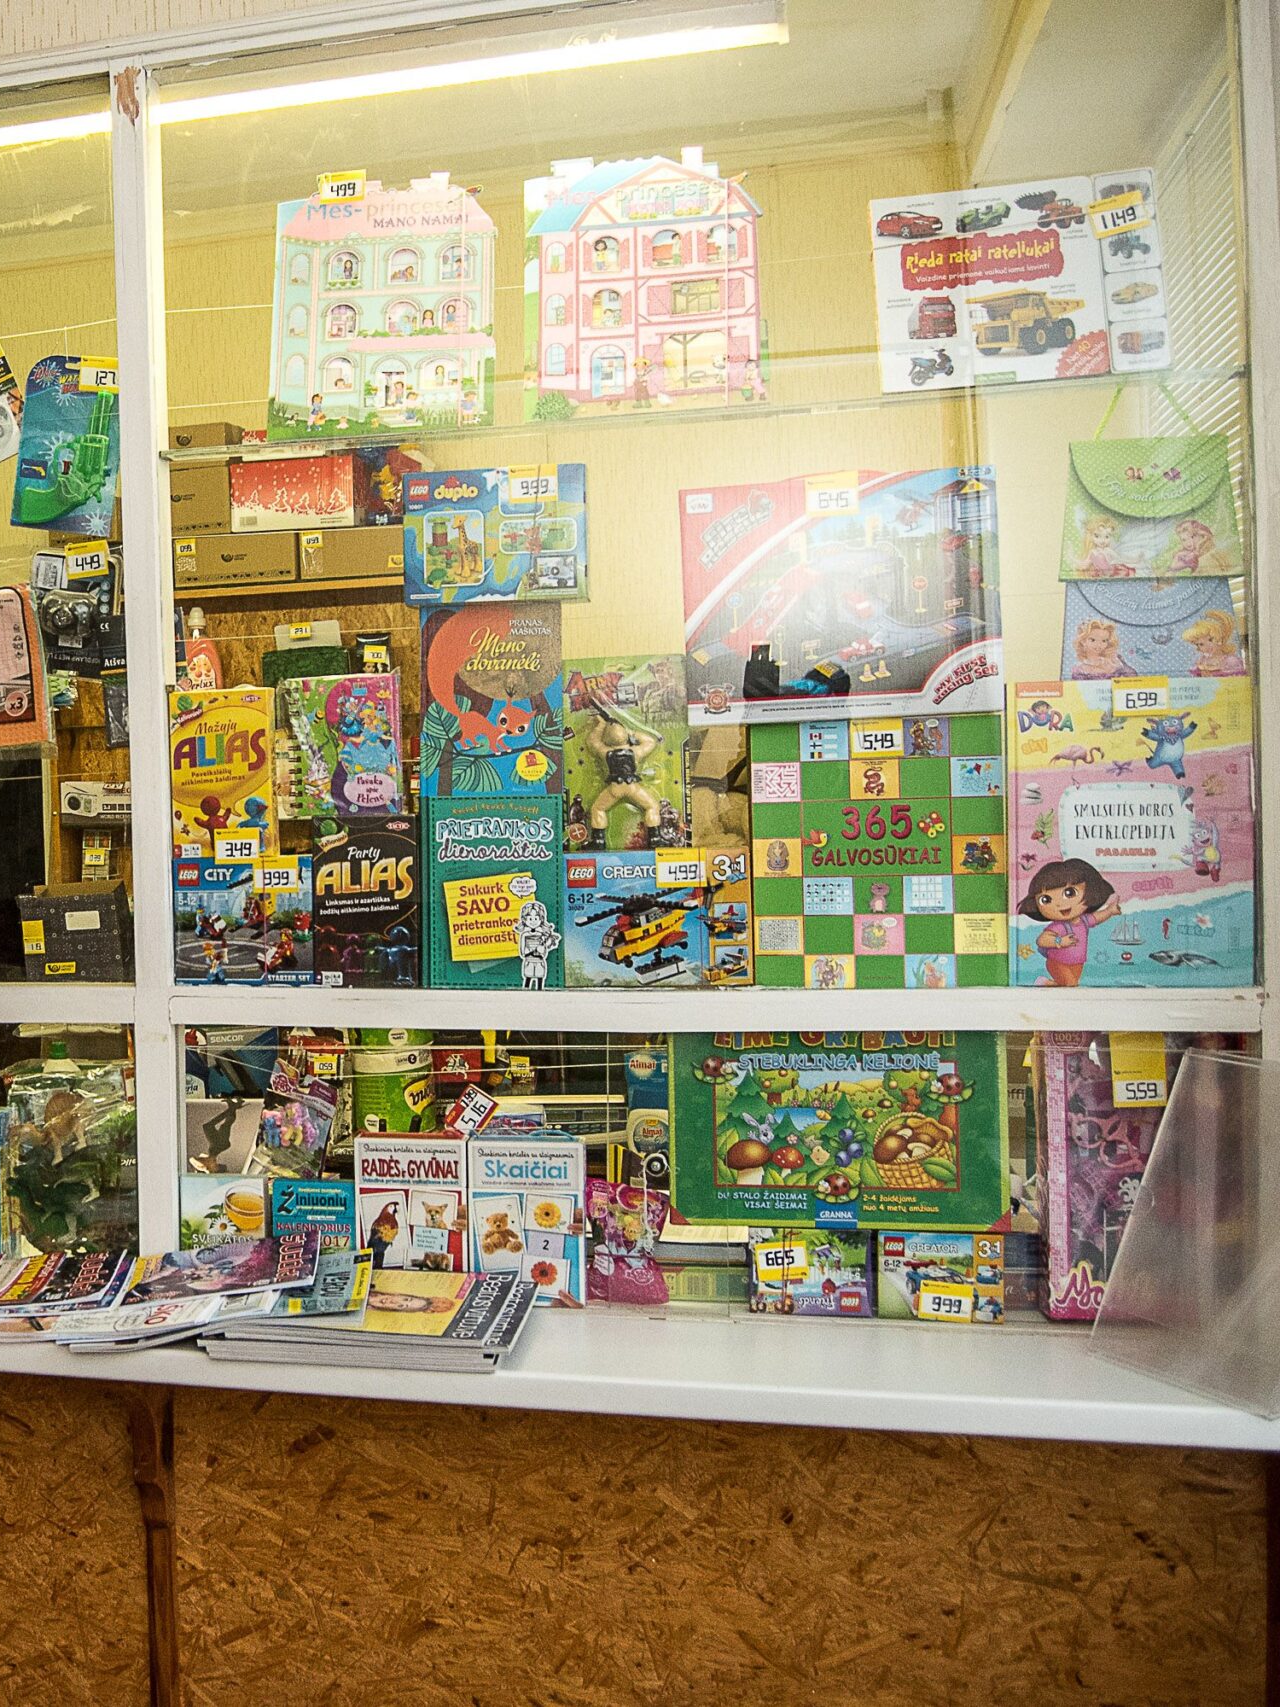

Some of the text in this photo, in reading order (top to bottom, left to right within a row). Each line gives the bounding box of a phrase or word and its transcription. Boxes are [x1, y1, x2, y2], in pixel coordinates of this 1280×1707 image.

[306, 203, 363, 221] Mes-
[372, 213, 470, 230] MANO NAMAI
[905, 237, 1056, 275] Rieda ratai rateliukai
[409, 482, 479, 501] LEGO duplo
[508, 619, 543, 627] PRANAS
[509, 626, 552, 636] MAŠIOTAS
[468, 625, 526, 655] Mano
[465, 654, 541, 673] dovanėlė
[974, 662, 999, 680] Set
[9, 696, 24, 711] x3
[1017, 699, 1075, 734] DORA
[194, 719, 238, 735] Mažųjų
[172, 728, 267, 772] ALIAS
[190, 767, 233, 778] Paveikslėlių
[214, 775, 246, 784] žaidimas
[1073, 800, 1175, 819] SMALSUTĖS DOROS
[435, 816, 554, 842] PRIETRANKOS
[840, 804, 914, 841] 365
[1074, 823, 1176, 841] ENCIKLOPEDIJA
[347, 846, 381, 863] Party
[438, 841, 552, 861] dienoraštis
[811, 844, 942, 868] GALVOSŪKIAI
[1094, 847, 1158, 857] PASAULIS
[178, 867, 233, 882] LEGO CITY
[316, 856, 414, 900] ALIAS
[567, 865, 596, 879] LEGO
[458, 881, 505, 899] Sukurk
[1131, 875, 1175, 893] earth
[177, 896, 197, 906] 5-12
[325, 895, 391, 907] Linksmas ir azartiškas
[456, 895, 511, 917] SAVO
[567, 892, 595, 905] 6-12
[319, 904, 400, 917] žodžių aiškinimo žaidimas!
[452, 916, 520, 935] prietrankos
[297, 974, 311, 982] SET
[209, 1035, 244, 1043] SENCOR
[737, 1048, 941, 1072] STEBUKLINGA KELIONĖ
[361, 1154, 459, 1180] RAIDĖS GYVŪNAI
[484, 1158, 569, 1180] Skaičiai
[732, 1191, 762, 1201] STALO
[762, 1189, 808, 1201] ŽAIDIMAI
[862, 1194, 917, 1205] 2-4 žaidėjams
[743, 1198, 808, 1210] VISAI ŠEIMAI
[862, 1202, 940, 1214] nuo 4 metų amžiaus
[819, 1210, 854, 1219] GRANNA
[275, 1222, 351, 1233] KALENDORIUS
[542, 1238, 550, 1250] 2
[884, 1241, 960, 1255] LEGO CREATOR
[883, 1259, 902, 1268] 6-12
